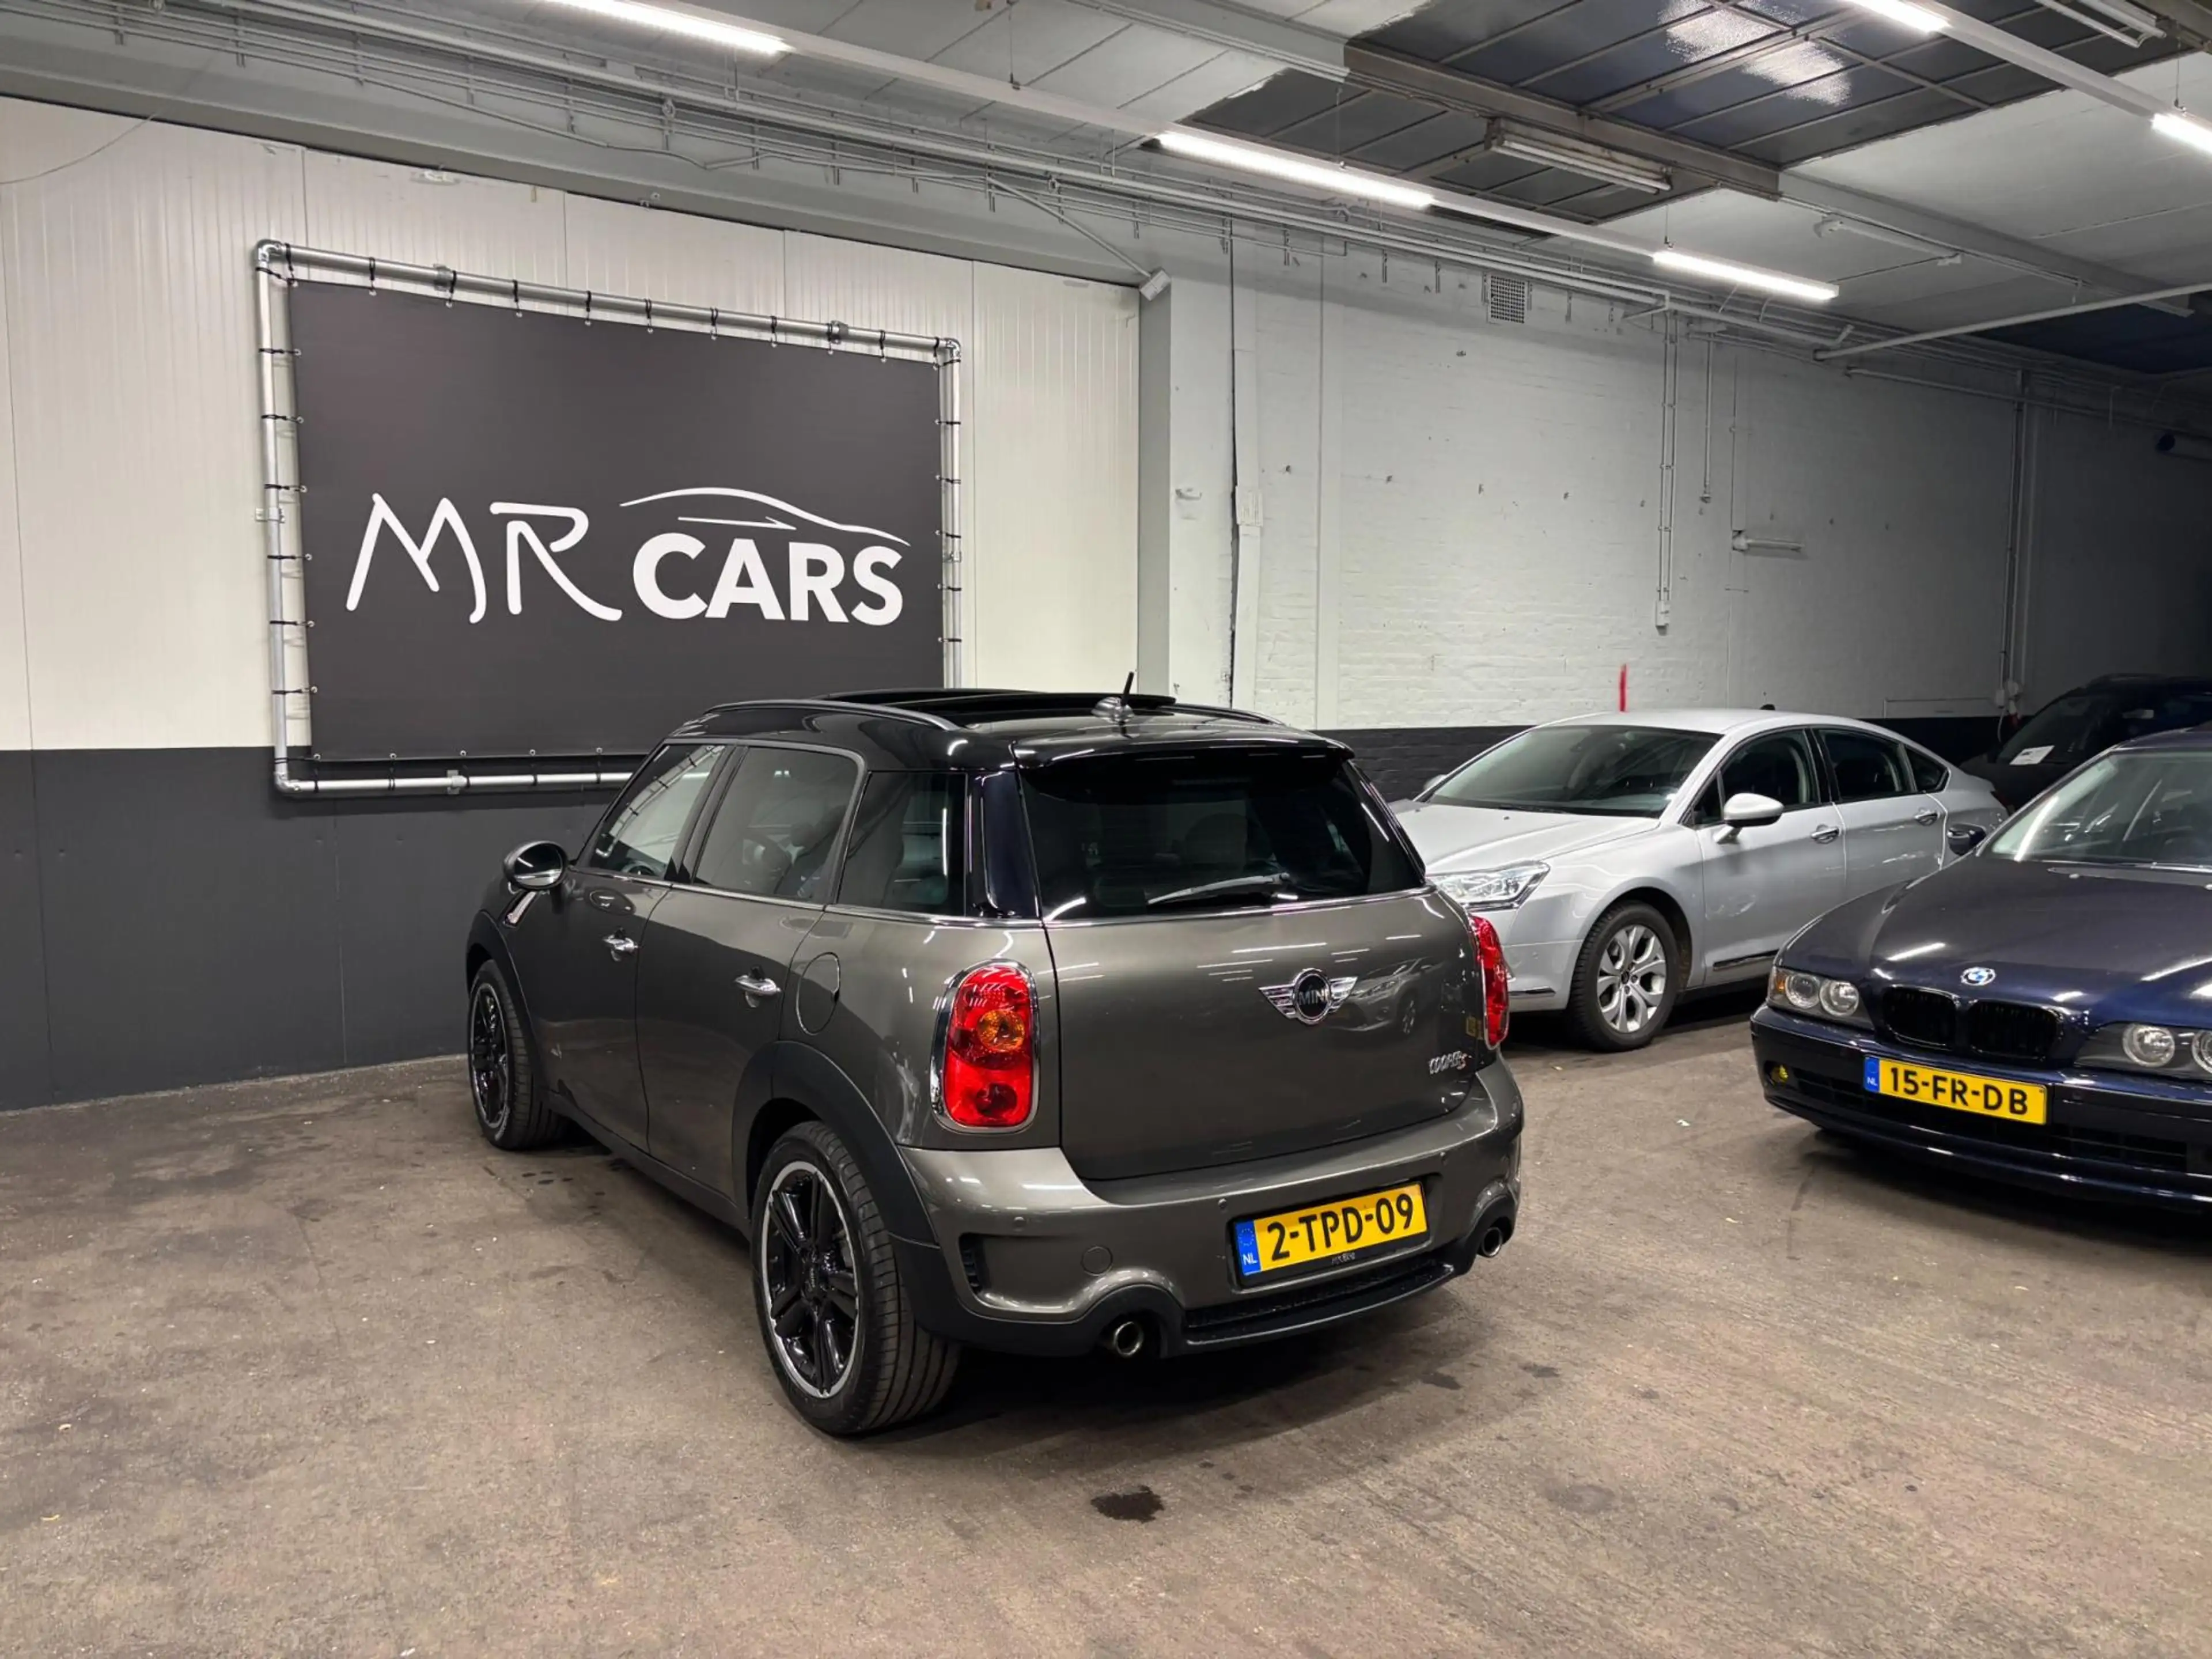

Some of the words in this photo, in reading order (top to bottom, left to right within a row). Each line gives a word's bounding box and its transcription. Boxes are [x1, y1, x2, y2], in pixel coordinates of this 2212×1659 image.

[346, 493, 622, 623] MR
[633, 533, 903, 626] CARS
[1298, 988, 1328, 1005] MINI
[1867, 1077, 1878, 1086] NL
[1891, 1067, 2028, 1116] 15-FR-DB
[1267, 1193, 1413, 1262] 2-TPD-09
[1243, 1252, 1257, 1266] NL
